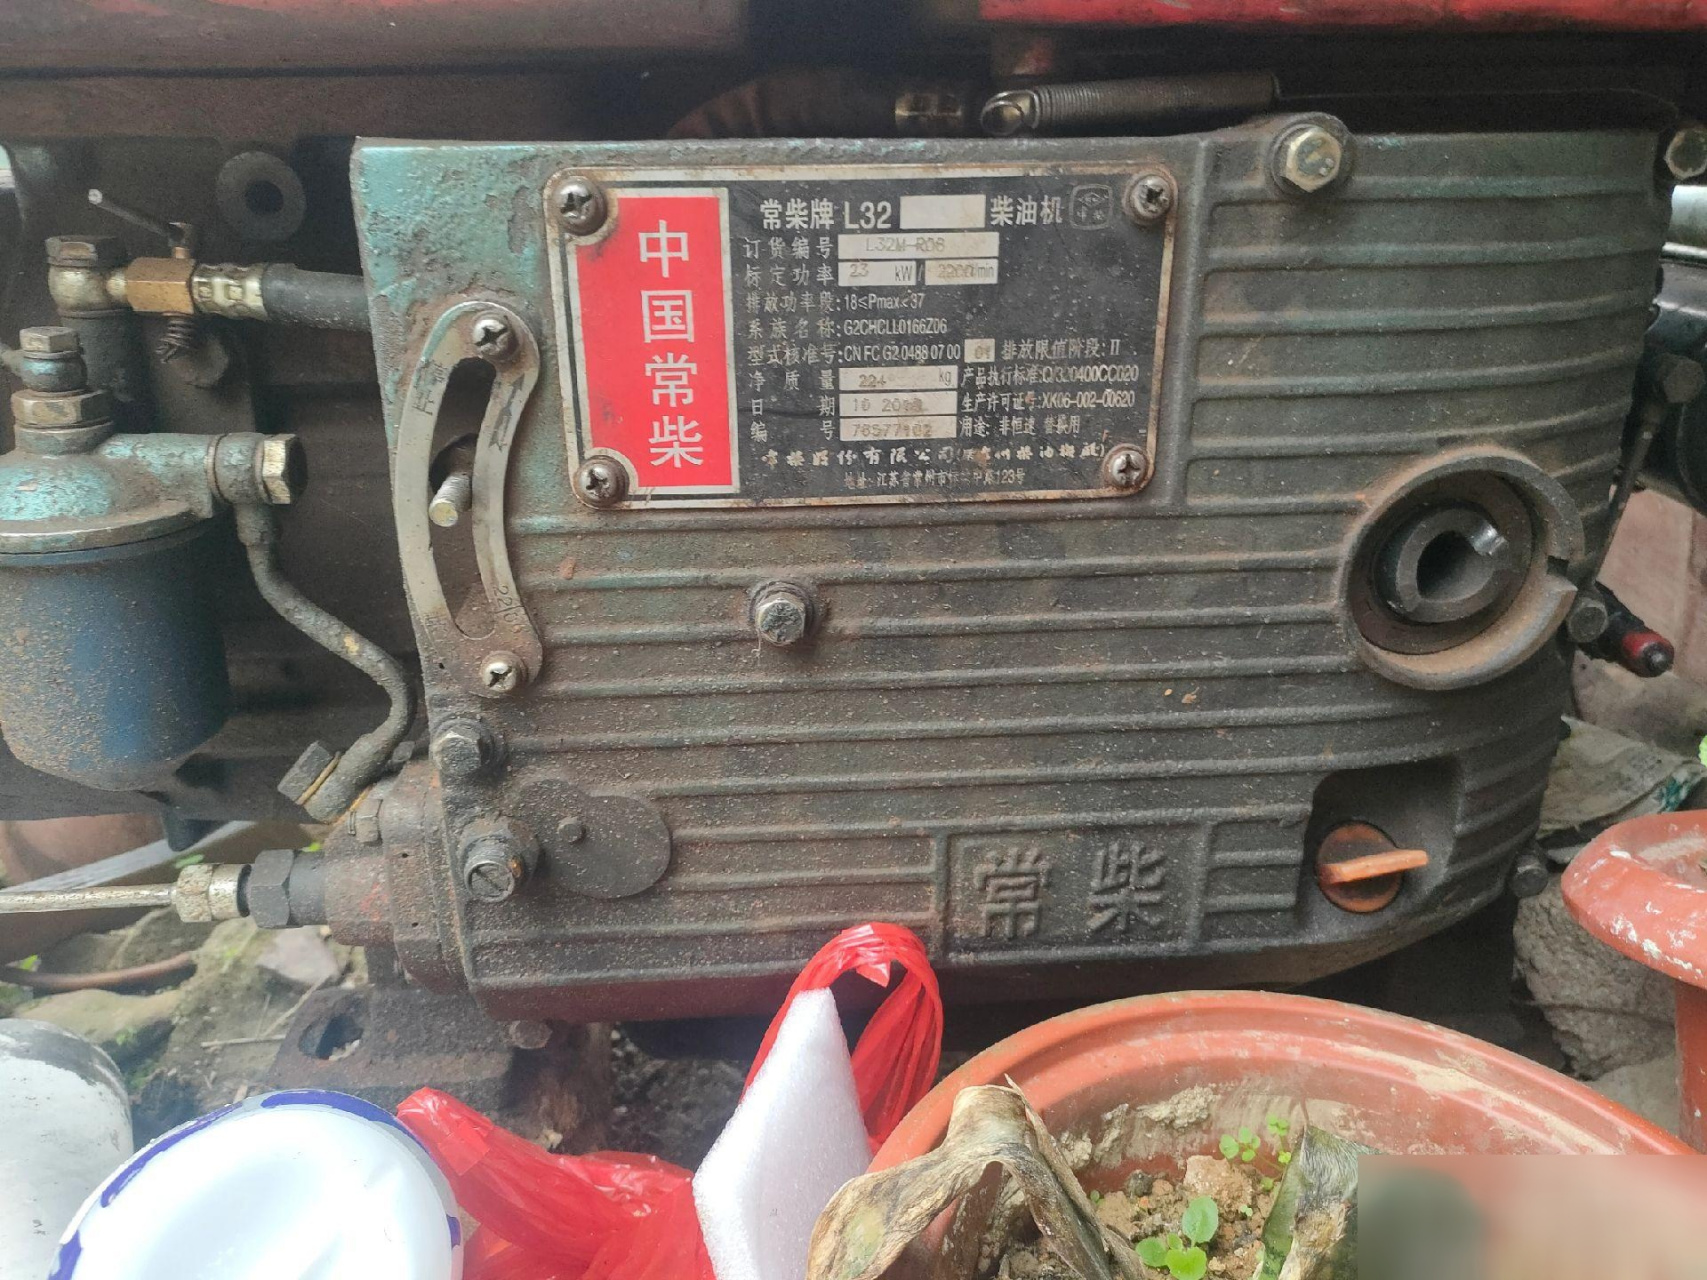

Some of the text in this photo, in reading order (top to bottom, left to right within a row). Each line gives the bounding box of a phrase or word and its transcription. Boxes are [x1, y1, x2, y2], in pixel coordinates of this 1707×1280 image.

[760, 198, 835, 230] 常柴牌
[844, 201, 892, 230] L32
[990, 195, 1062, 226] 柴油机
[743, 236, 834, 260] 订货编号
[744, 263, 835, 287] 标定功率
[638, 219, 703, 468] 中国常柴
[973, 841, 1167, 940] 常柴
